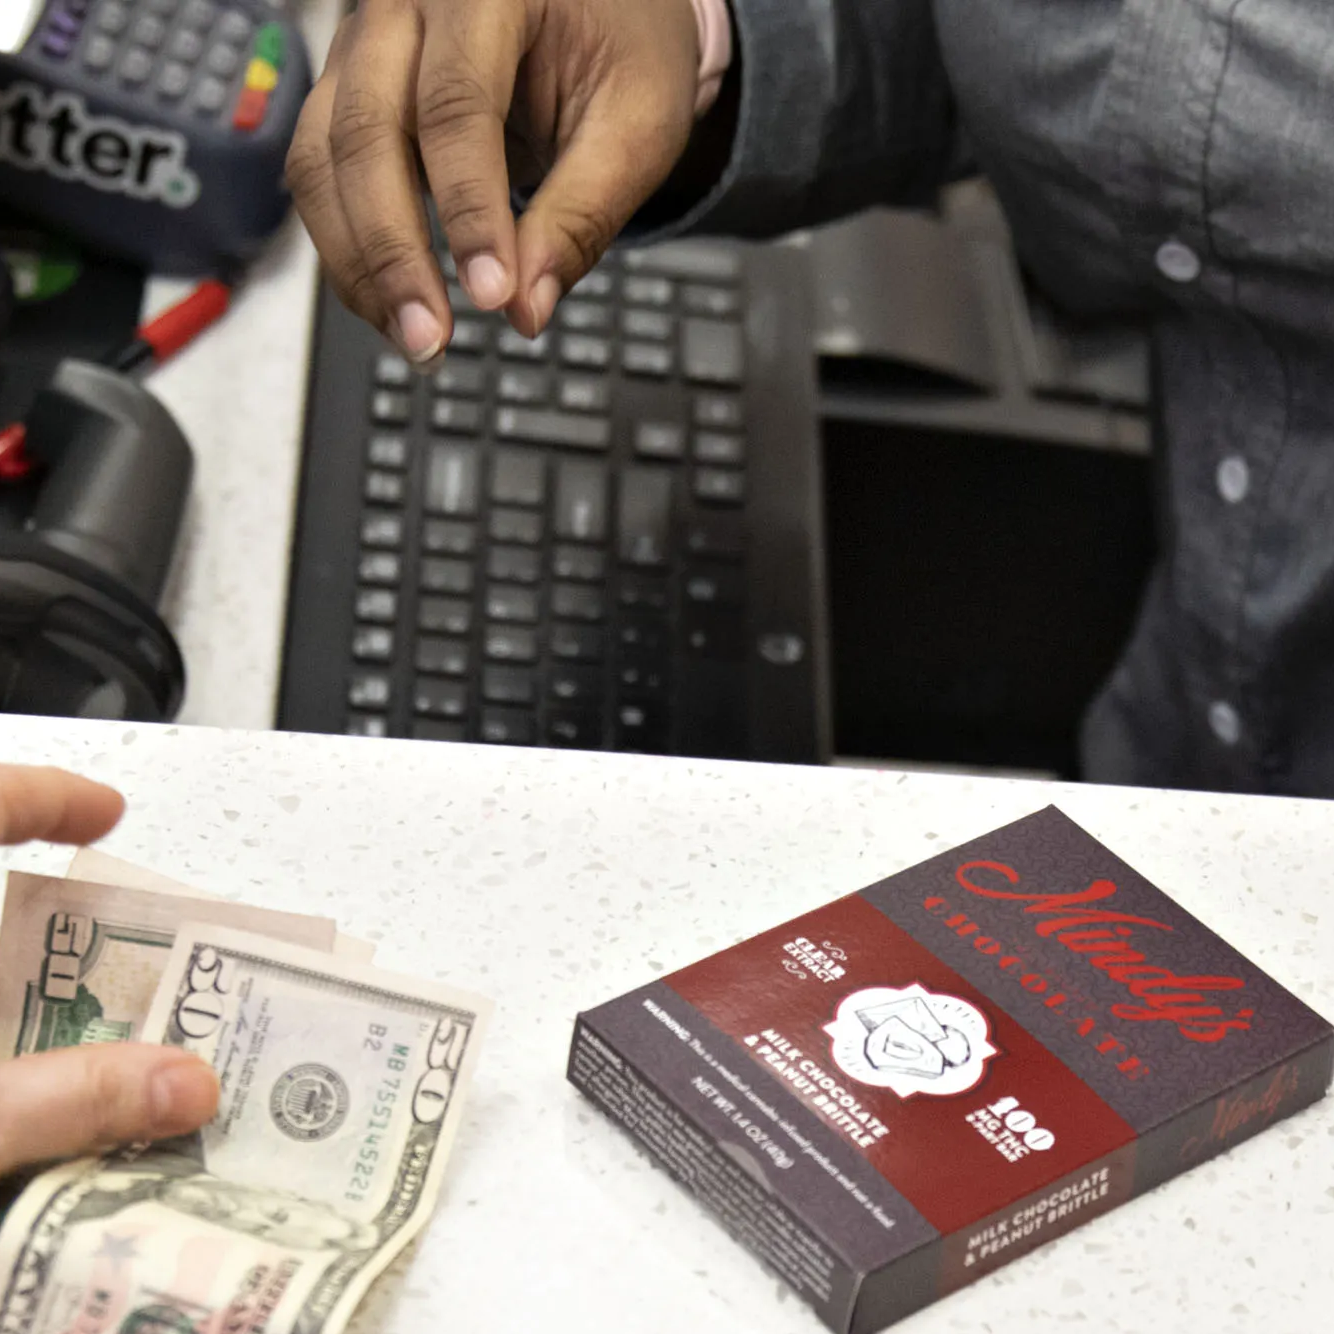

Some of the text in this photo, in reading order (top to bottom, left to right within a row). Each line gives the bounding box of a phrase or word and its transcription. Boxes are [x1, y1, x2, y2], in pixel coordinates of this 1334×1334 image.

[177, 945, 229, 1038] 50
[783, 942, 836, 984] EXTRACT
[795, 937, 846, 980] CLEAR
[923, 896, 1150, 1080] CHOCOLATE
[955, 861, 1254, 1042] Mindy's
[363, 1022, 388, 1052] B2
[412, 1016, 463, 1123] 50
[643, 999, 691, 1043] WARNING:
[688, 1037, 706, 1056] This
[717, 1064, 750, 1093] medical
[802, 1145, 840, 1177] product
[837, 1174, 856, 1193] and
[691, 1075, 718, 1098] NET
[743, 1034, 877, 1149] & PEANUT BRITTLE
[761, 1029, 890, 1138] MILK CHOCOLATE
[987, 1096, 1055, 1151] 100
[974, 1109, 1031, 1159] MG THC
[964, 1182, 1109, 1267] & PEANUT BRITTLE
[967, 1166, 1109, 1250] MILK CHOCOLATE
